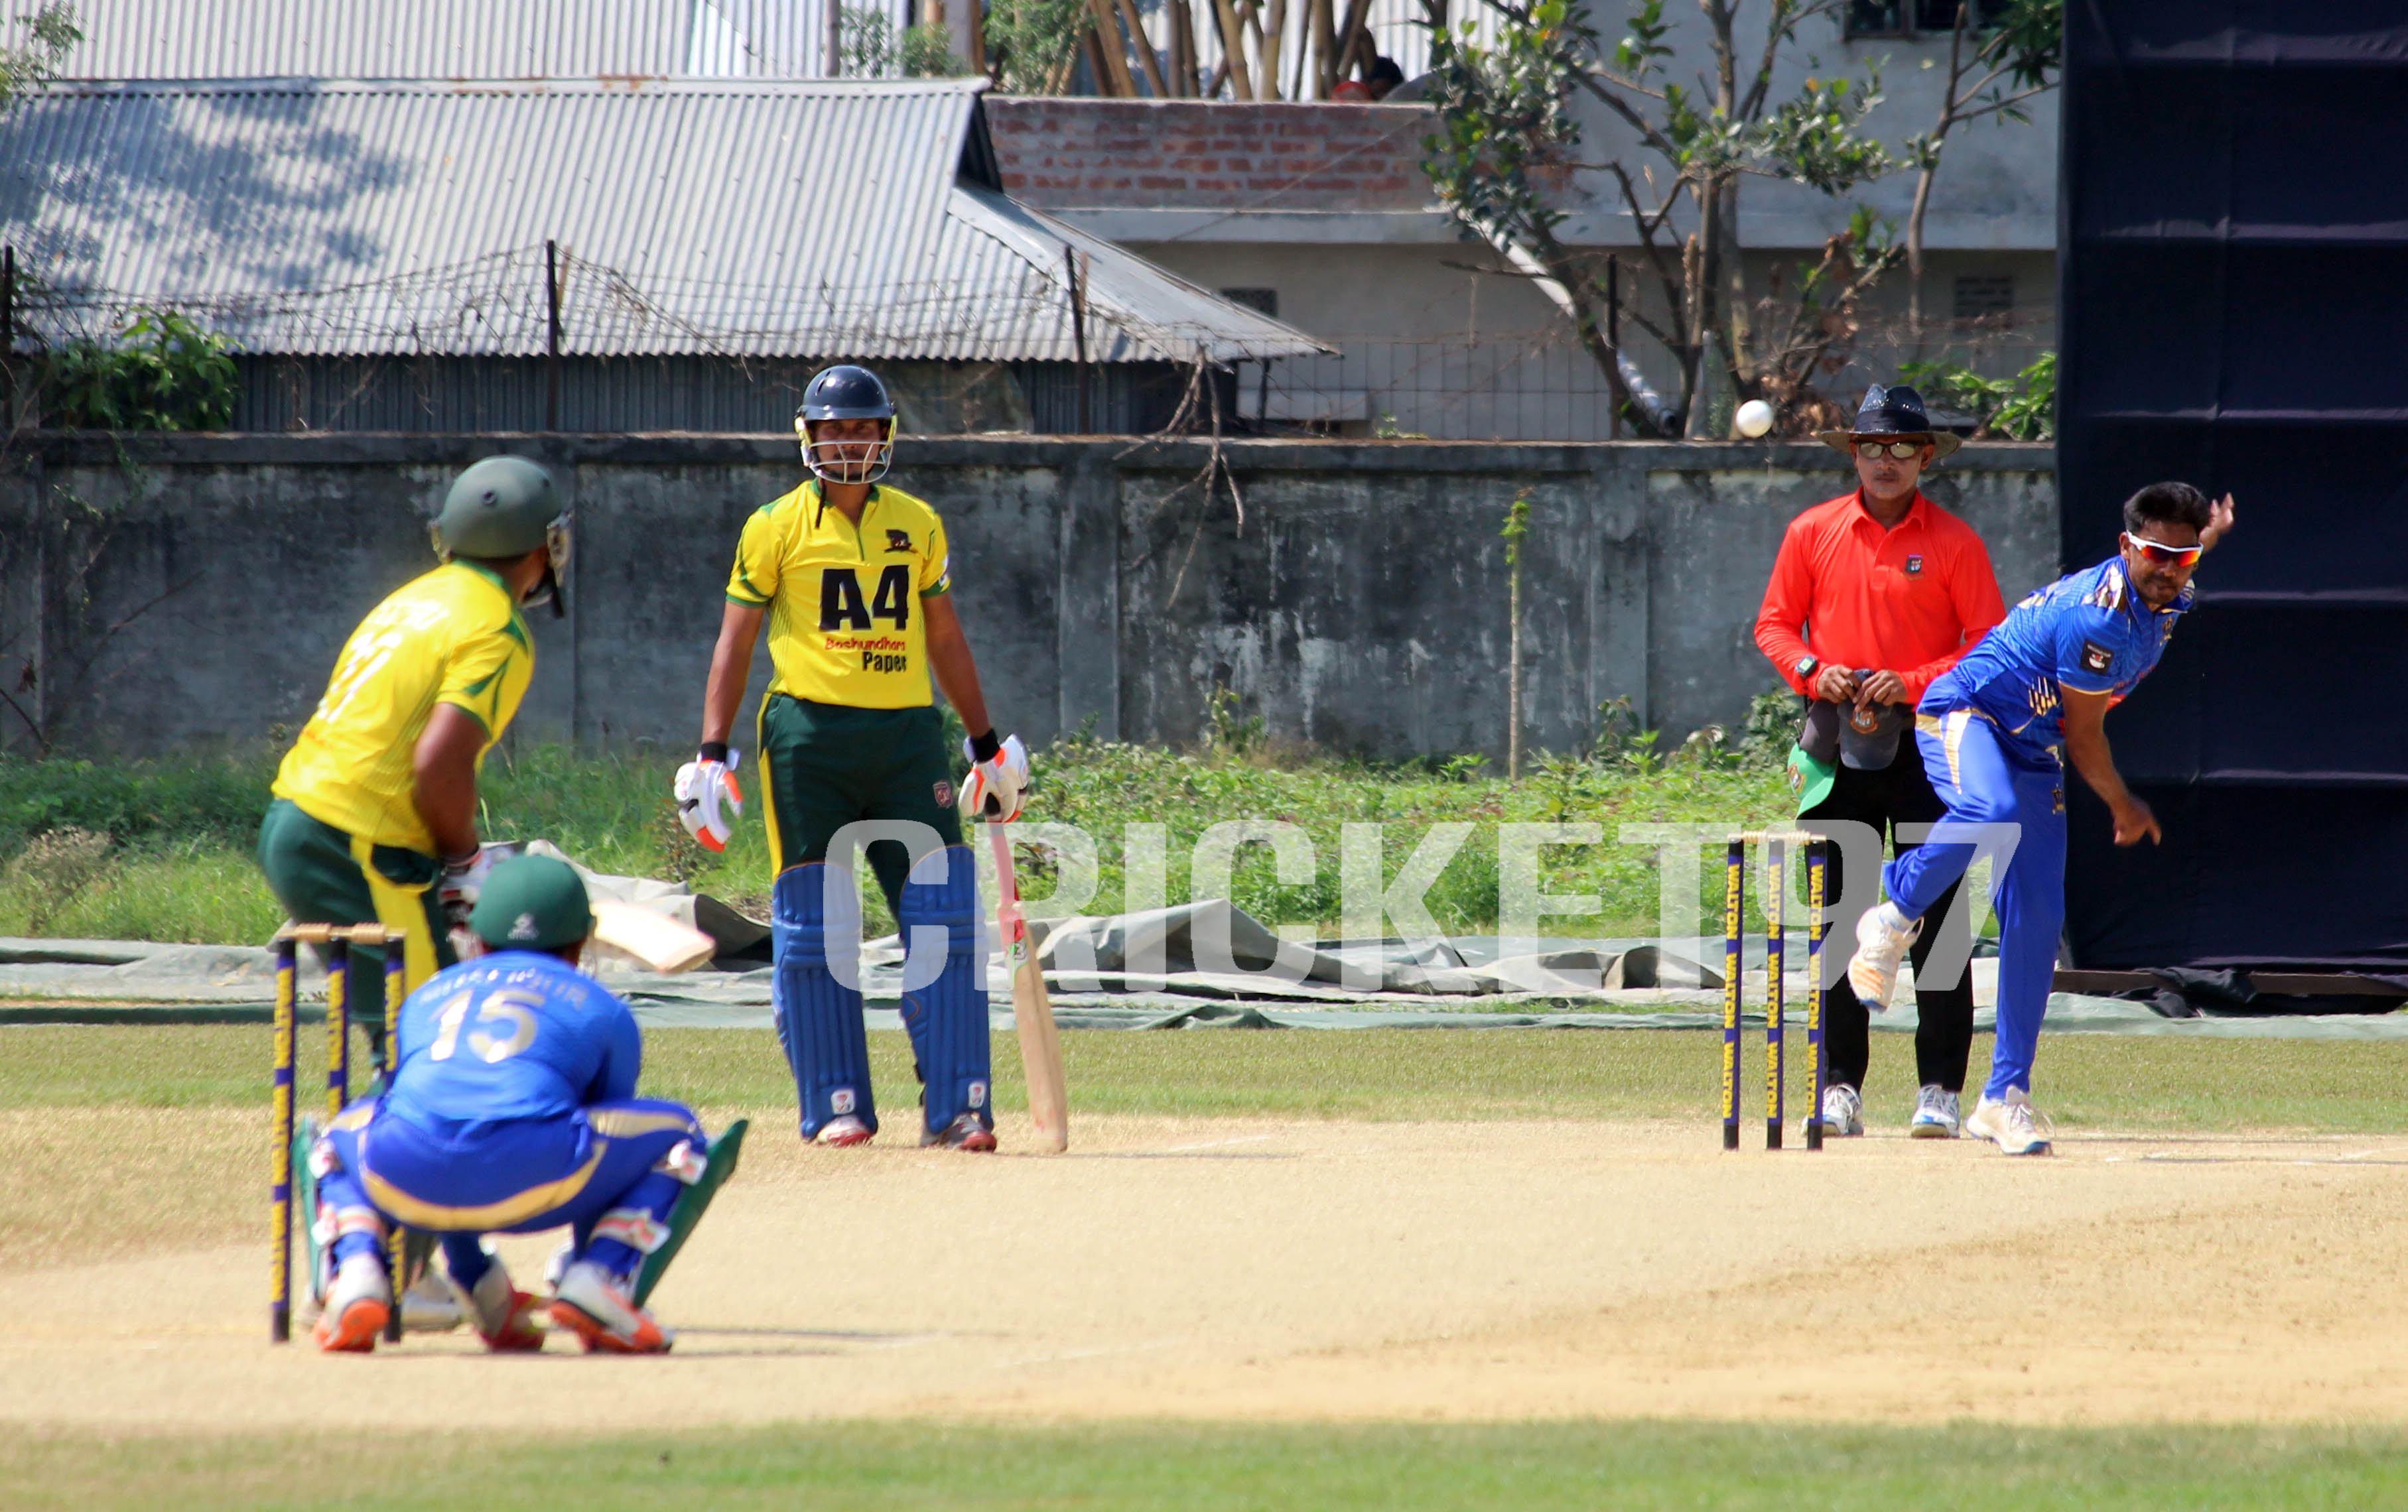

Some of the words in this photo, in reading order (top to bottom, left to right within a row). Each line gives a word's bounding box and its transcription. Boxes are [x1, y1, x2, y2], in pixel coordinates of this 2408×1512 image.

[818, 564, 909, 631] A4
[862, 651, 907, 674] Paper
[1727, 863, 1740, 940] WALTON
[1768, 863, 1782, 940] WALTON
[1810, 864, 1824, 940] WALTON
[429, 988, 545, 1064] 15
[1725, 953, 1738, 1029] WALTON
[1767, 952, 1780, 1029] WALTON
[1722, 1042, 1735, 1118] WALTON
[1767, 1042, 1778, 1118] WALTON
[1808, 1042, 1818, 1119] WALTON
